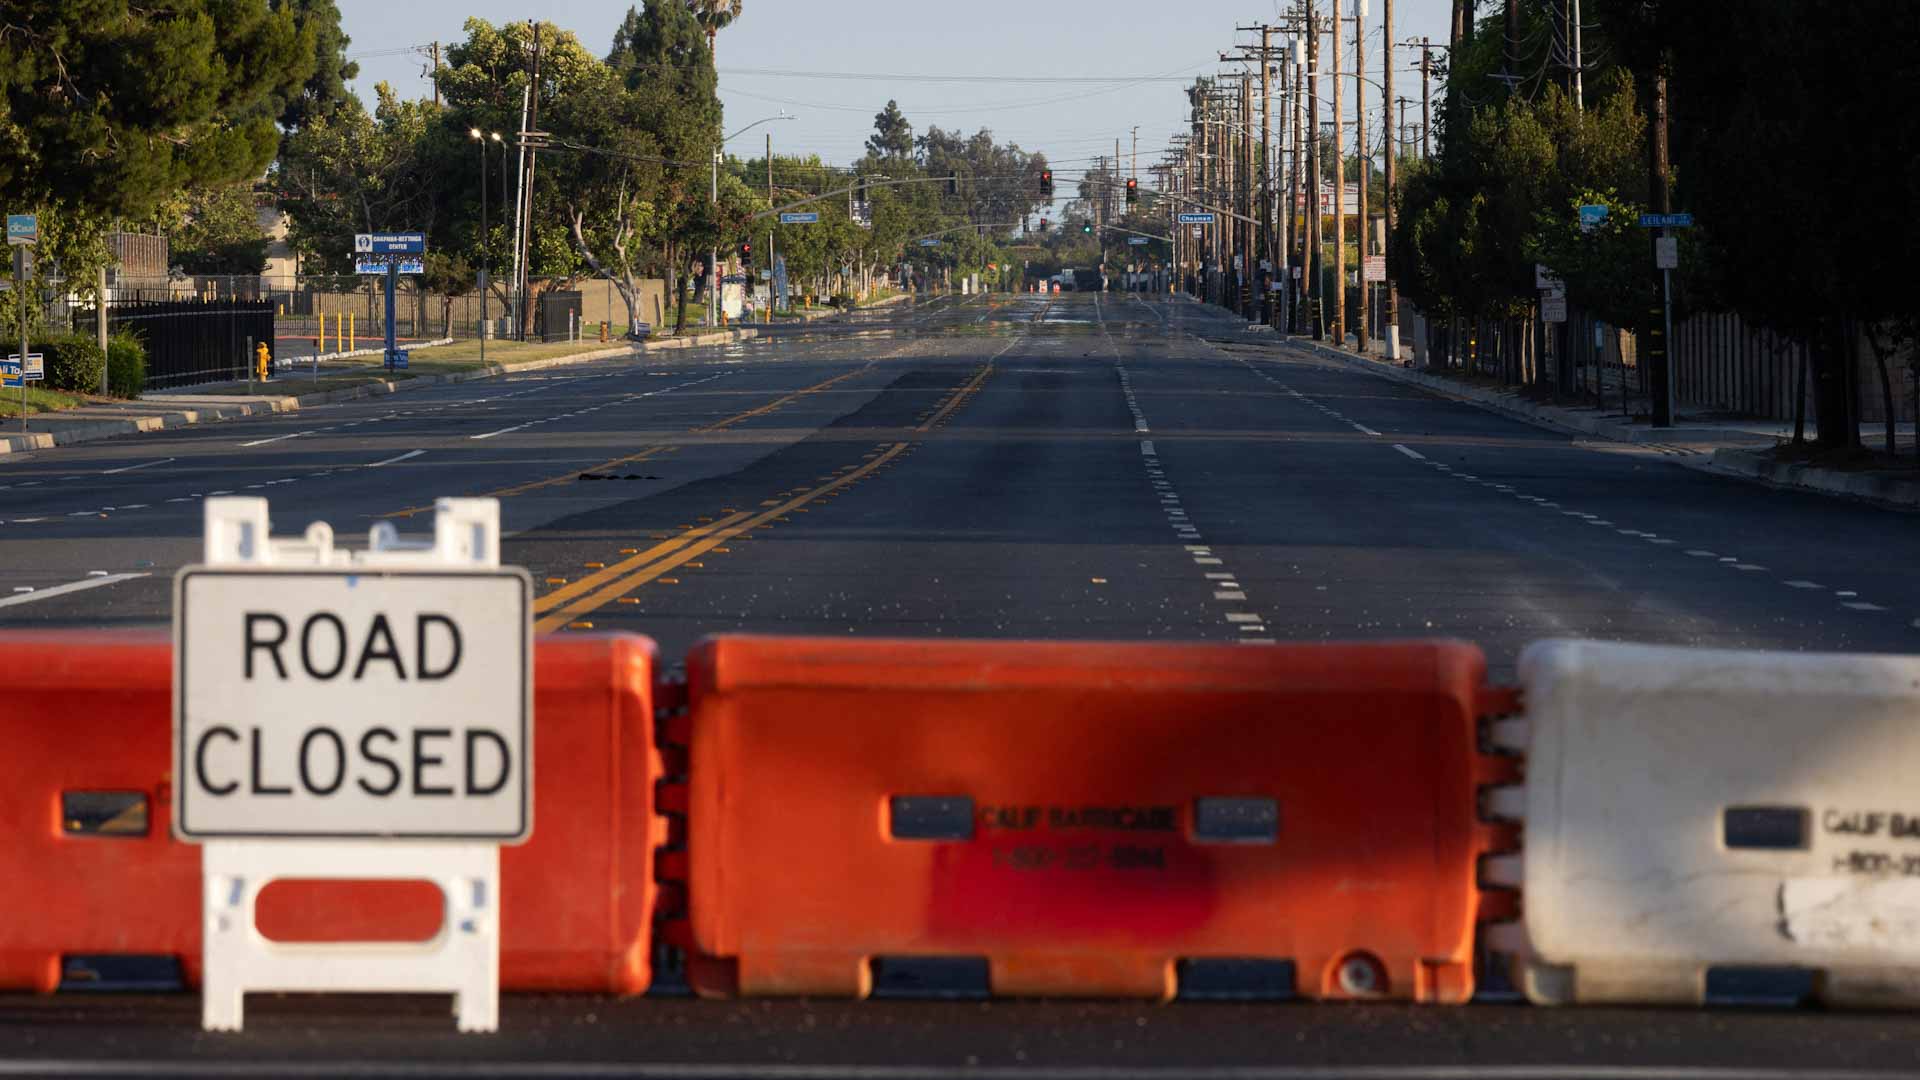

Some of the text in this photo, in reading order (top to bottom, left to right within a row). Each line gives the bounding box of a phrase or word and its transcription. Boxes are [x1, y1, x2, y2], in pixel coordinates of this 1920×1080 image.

[1180, 215, 1212, 223] Chapman
[1642, 215, 1676, 225] LEILANI
[244, 612, 463, 680] ROAD
[195, 726, 512, 797] CLOSED
[1824, 810, 1887, 834] CALIF
